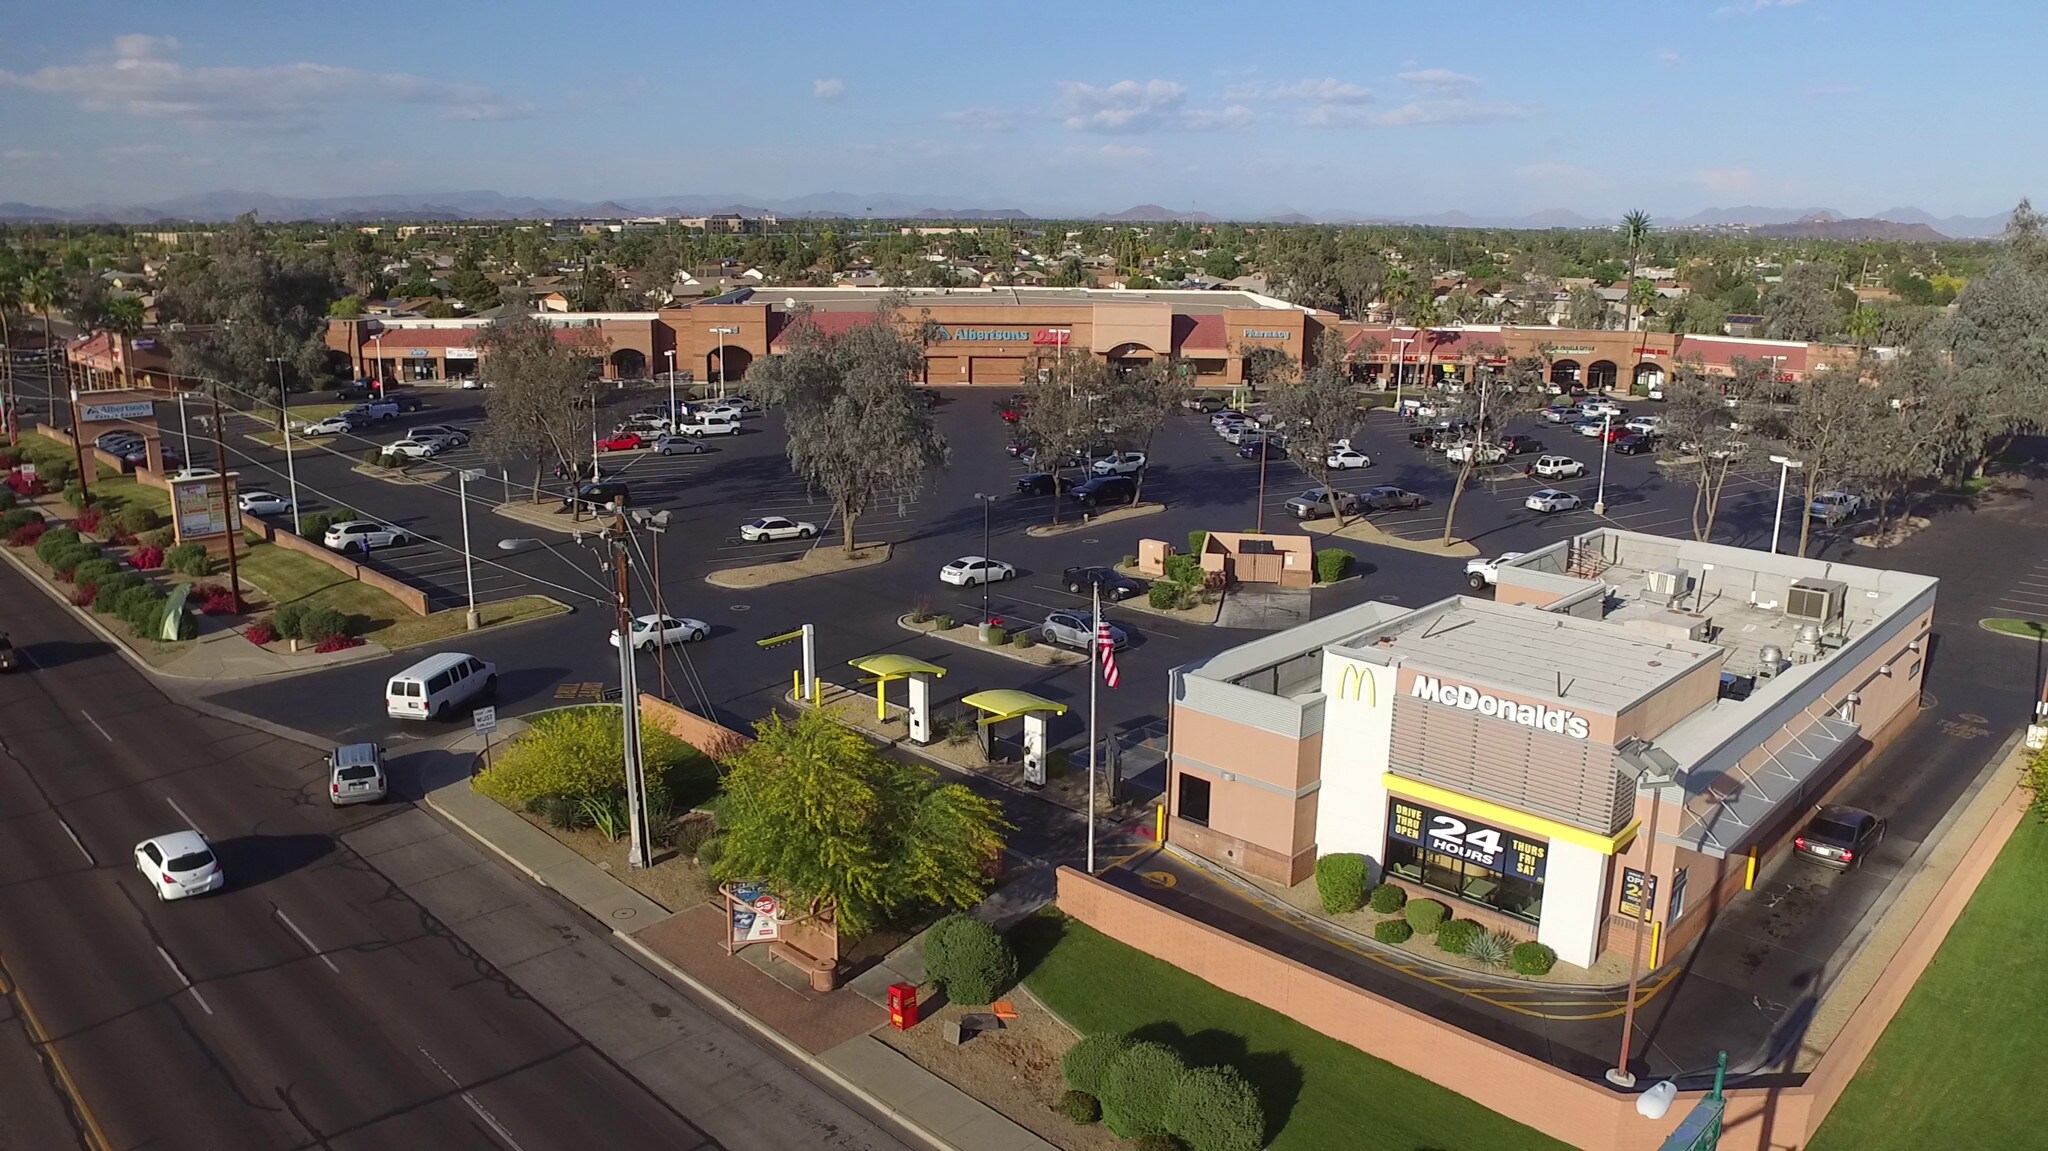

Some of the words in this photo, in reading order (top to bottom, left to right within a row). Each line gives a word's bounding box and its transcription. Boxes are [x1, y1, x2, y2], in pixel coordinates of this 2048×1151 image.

[954, 328, 1029, 341] Albertsons
[1243, 329, 1291, 340] Pharmacy
[1411, 674, 1590, 739] McDonald's
[1395, 804, 1423, 821] DRIVE
[1396, 814, 1420, 830] THRU
[1394, 824, 1419, 840] OPEN
[1428, 815, 1504, 856] 24
[1432, 839, 1494, 866] HOURS
[1512, 839, 1545, 859] THURS
[1518, 852, 1536, 866] FRI
[1516, 862, 1536, 877] SAT
